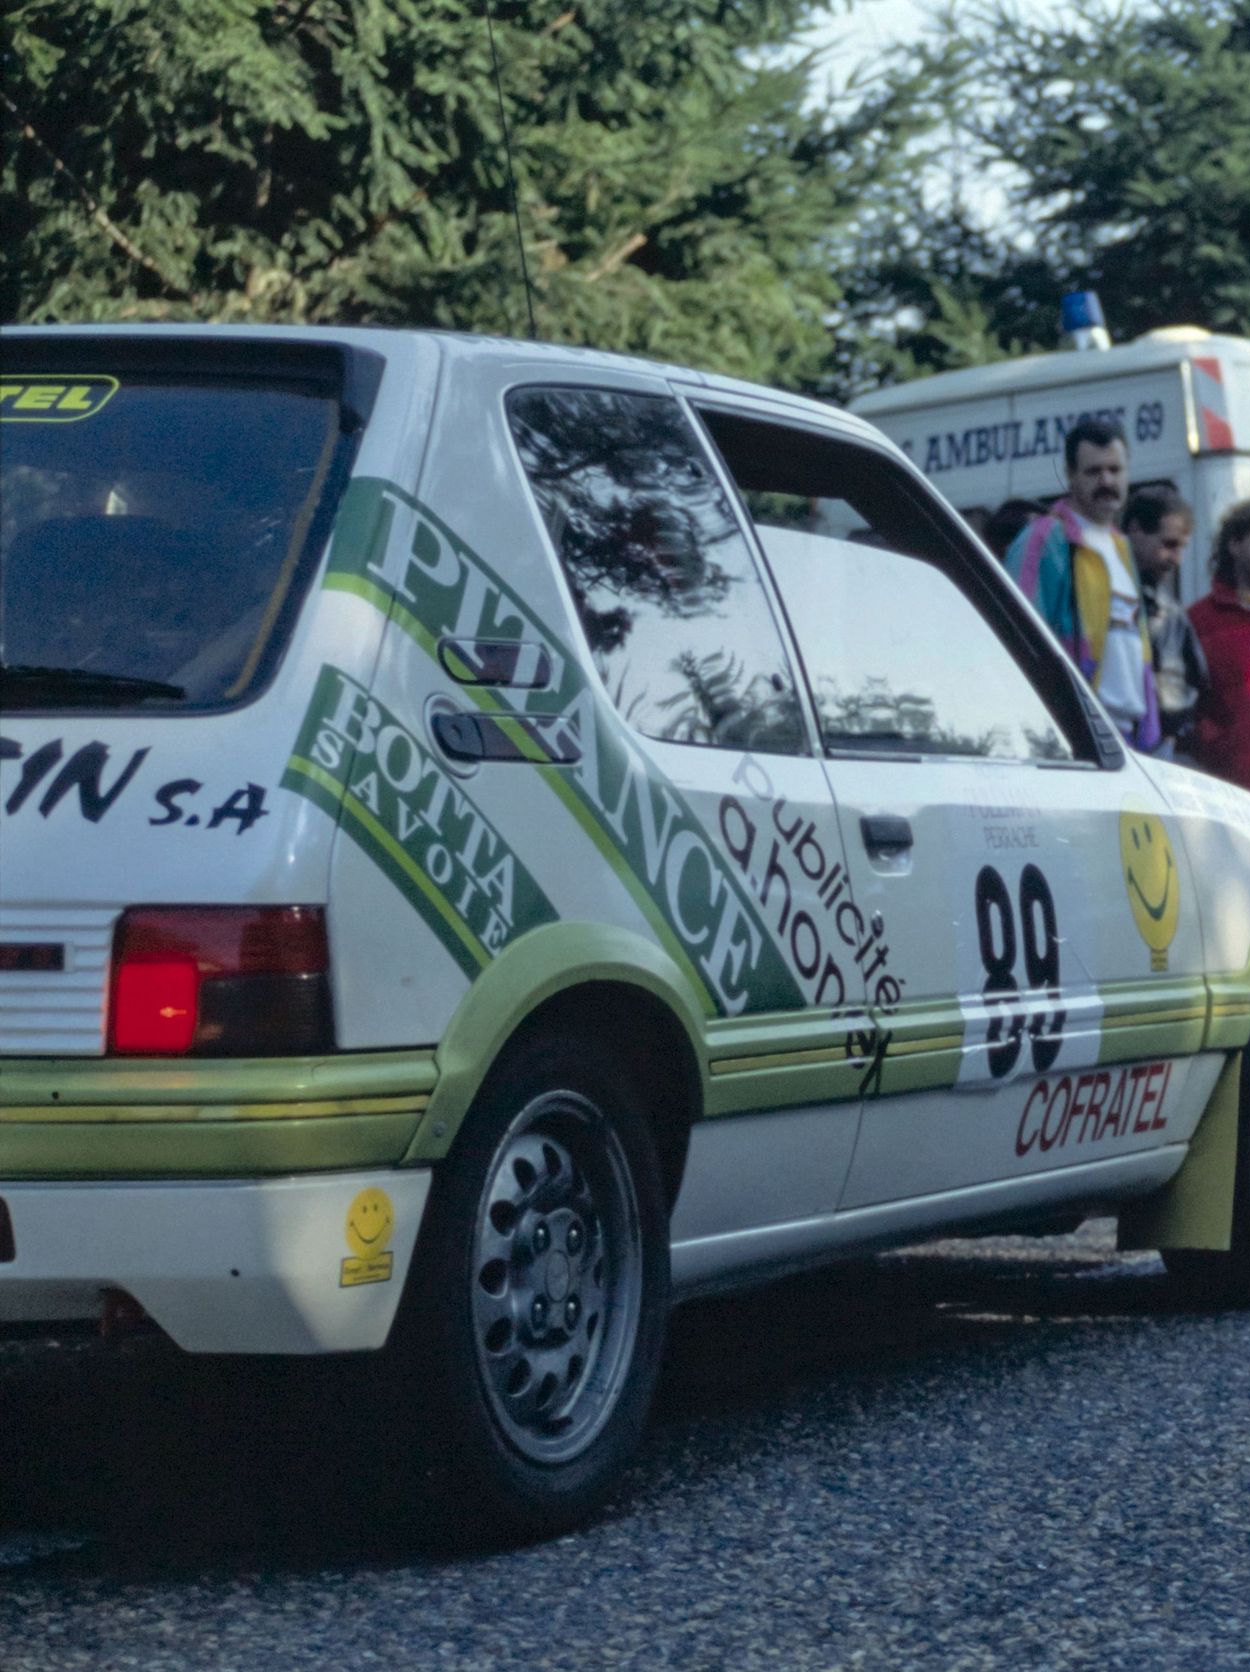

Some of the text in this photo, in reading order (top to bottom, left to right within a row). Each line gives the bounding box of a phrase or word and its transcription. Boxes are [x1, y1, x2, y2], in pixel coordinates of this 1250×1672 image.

[1135, 401, 1164, 442] 69
[148, 776, 270, 836] S.A
[310, 728, 508, 960] SAVOIE
[321, 673, 516, 929] BOTTA
[730, 752, 907, 1017] publicité
[974, 861, 1067, 1079] 89
[1014, 1061, 1173, 1158] COFRATEL
